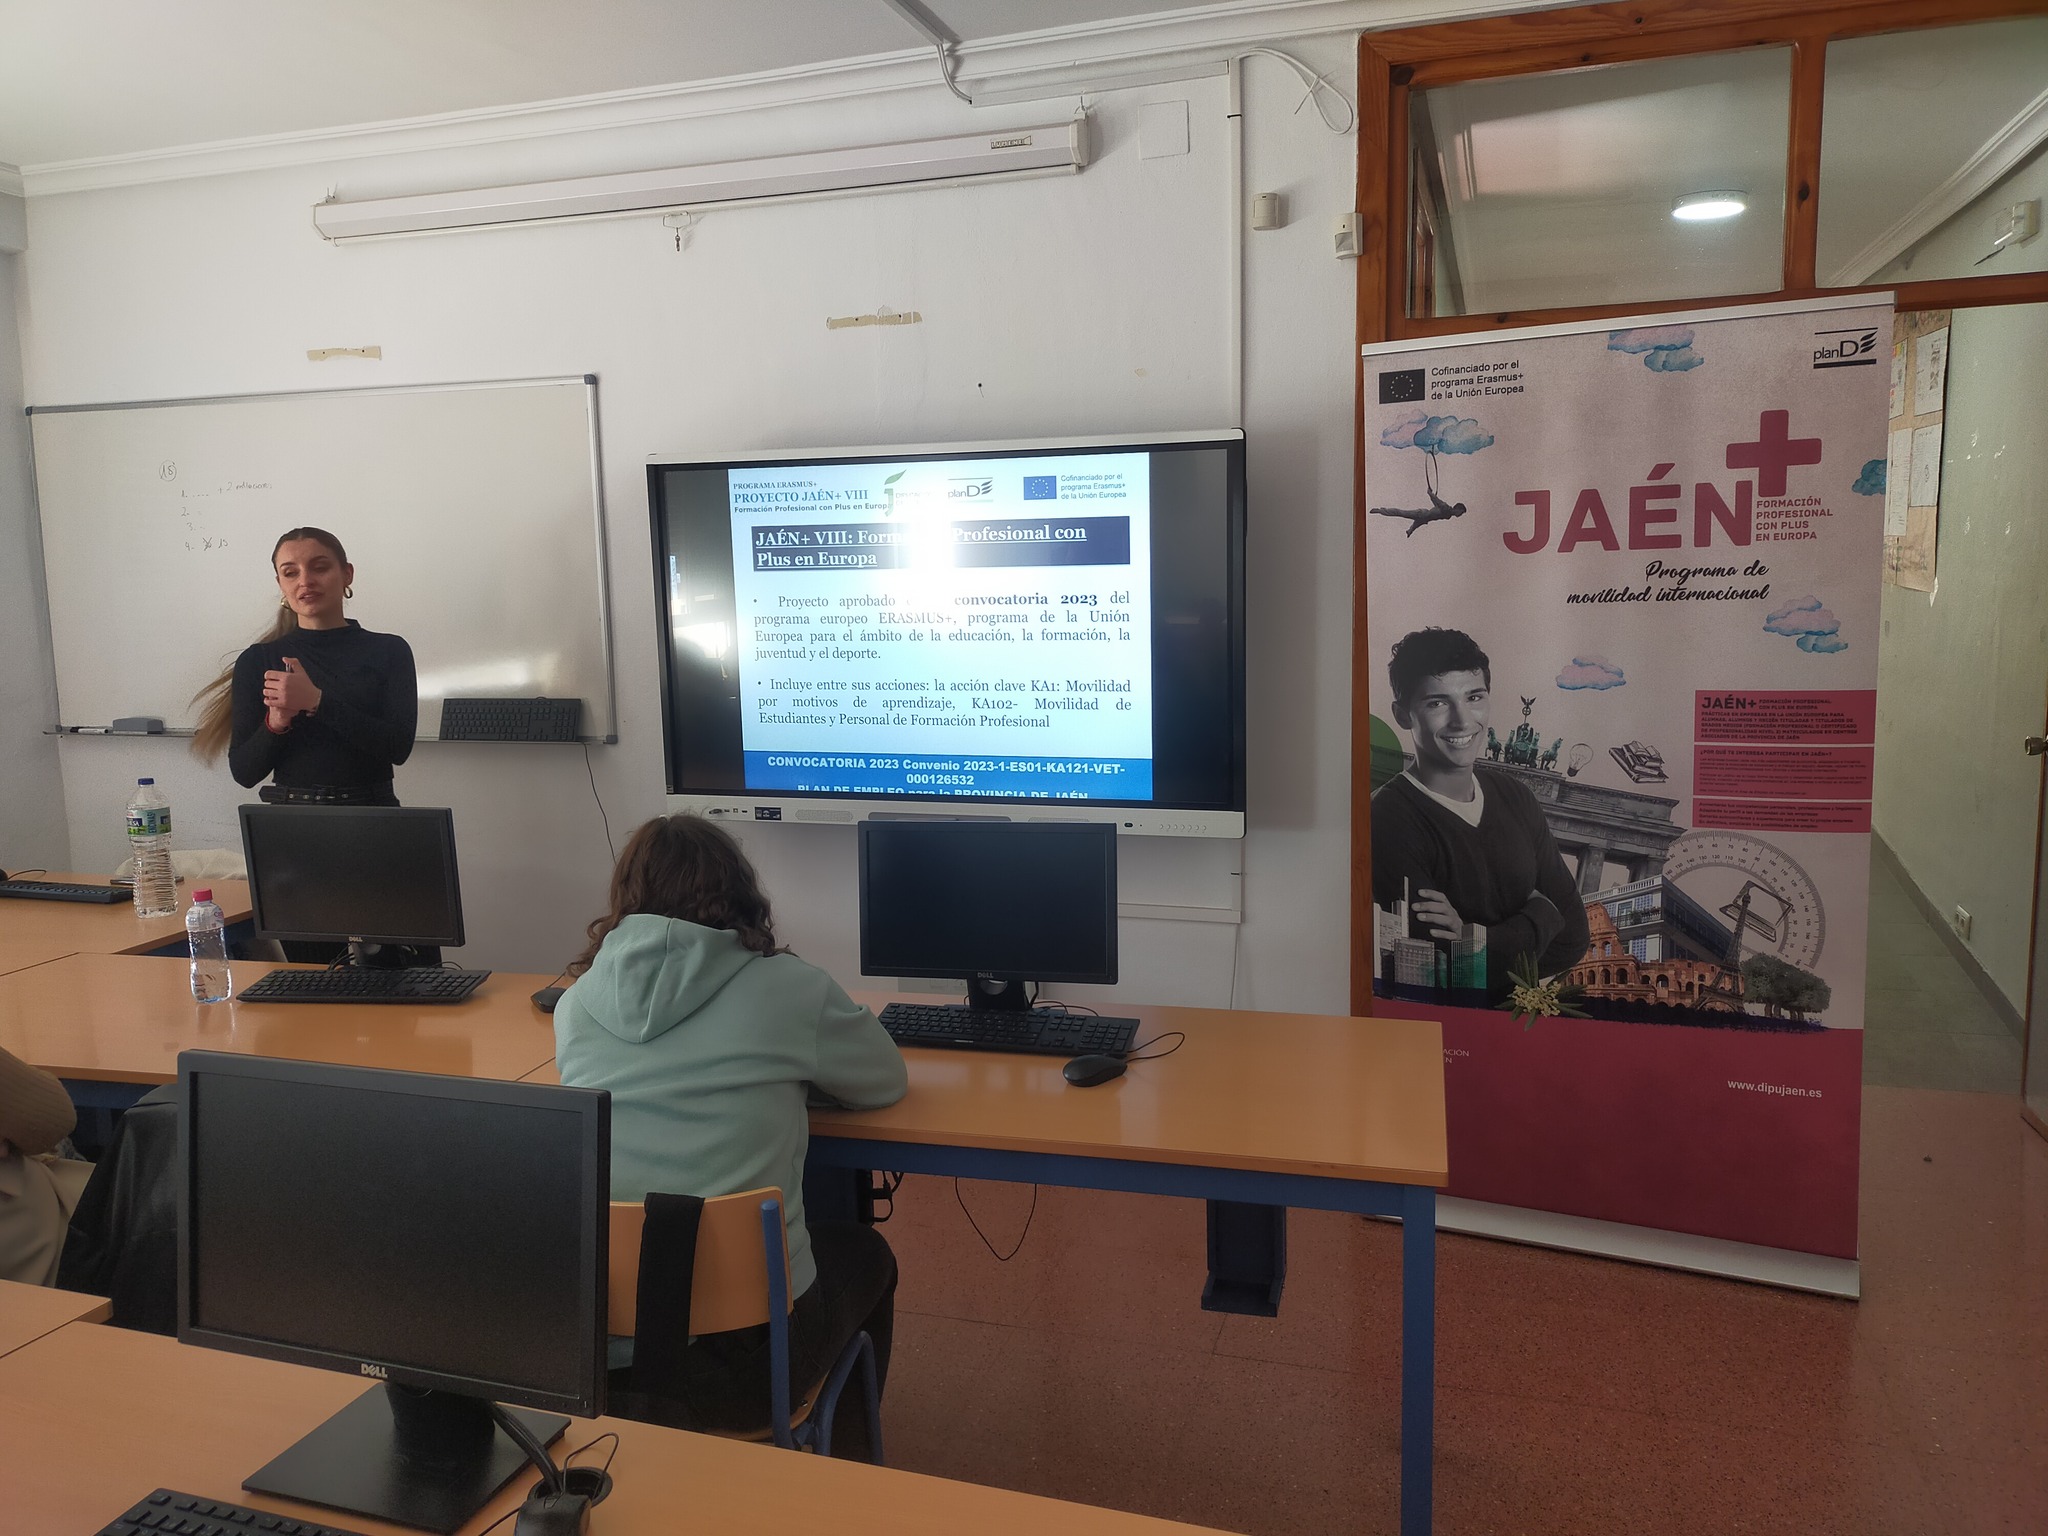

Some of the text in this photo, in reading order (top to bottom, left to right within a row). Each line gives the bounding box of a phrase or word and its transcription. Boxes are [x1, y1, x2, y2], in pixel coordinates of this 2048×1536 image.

[1431, 360, 1519, 376] Cofinanciado por el
[1431, 373, 1524, 390] programa Erasmus+
[1431, 385, 1524, 400] de la Unión Europea
[1060, 474, 1103, 482] Cofinanciado
[733, 482, 776, 490] PROGRAMA
[734, 489, 868, 503] PROYECTO JAÉN+ VIII
[1756, 496, 1821, 509] FORMACIÓN
[734, 505, 773, 513] Formación
[775, 504, 817, 512] Profesional
[1756, 508, 1833, 520] PROFESIONAL
[1756, 520, 1809, 531] CON PLUS
[755, 529, 811, 545] JAÉN+
[813, 531, 853, 544] VIII:
[953, 525, 1050, 542] Profesional
[1054, 527, 1087, 540] con
[1756, 531, 1817, 541] EN EUROPA
[756, 551, 878, 568] Plus en Europa
[1646, 559, 1770, 585] Programa de
[778, 595, 829, 610] Proyecto
[839, 594, 896, 610] aprobado
[954, 592, 1049, 606] convocatoria
[1060, 594, 1098, 607] 2023
[1110, 591, 1130, 604] del
[1566, 584, 1770, 604] movilidad internacional
[754, 615, 810, 627] programa
[820, 615, 868, 627] europeo
[967, 613, 1029, 626] programa
[1039, 610, 1055, 623] de
[1067, 610, 1078, 623] la
[1089, 609, 1130, 623] Unión
[755, 628, 1131, 644] Europea para el ámbito de la educación, la formación, la
[755, 647, 881, 662] juventud y el deporte.
[770, 678, 813, 693] Incluye
[816, 680, 847, 690] entre
[851, 681, 871, 690] sus
[875, 679, 930, 691] acciones:
[934, 679, 946, 691] la
[950, 679, 989, 692] acción
[994, 679, 1026, 692] clave
[1066, 679, 1131, 692] Movilidad
[758, 697, 778, 709] por
[792, 696, 839, 708] motivos
[853, 696, 868, 708] de
[882, 697, 956, 711] aprendizaje,
[1034, 698, 1099, 710] Movilidad
[1115, 698, 1132, 711] de
[1701, 694, 1757, 709] JAÉN+
[759, 712, 1050, 728] Estudiantes y Personal de Formación Profesional
[767, 756, 1125, 775] CONVOCATORIA 2023 Convenio 2023-1-ES01-KA121-VET-
[906, 773, 974, 785] 000126532
[1727, 1080, 1822, 1098] www.dipujaen.es
[361, 1363, 388, 1378] DELL
